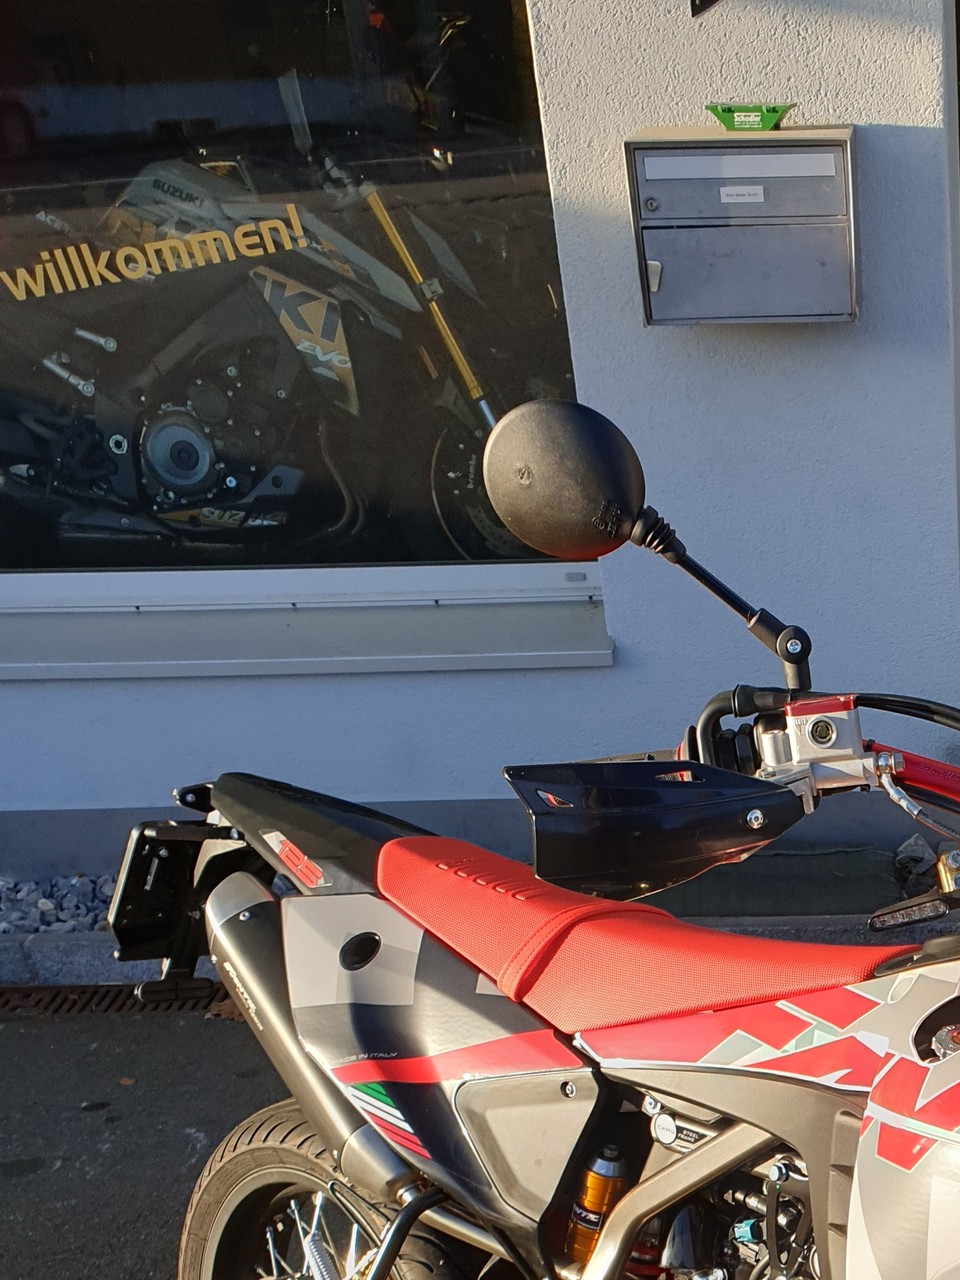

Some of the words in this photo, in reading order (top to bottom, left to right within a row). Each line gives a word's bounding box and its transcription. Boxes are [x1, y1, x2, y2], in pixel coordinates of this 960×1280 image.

[152, 179, 204, 208] SUZUKI
[0, 203, 308, 301] willkommen!
[278, 839, 324, 888] 125
[677, 1133, 696, 1143] FRAME
[682, 1130, 699, 1139] STEEL
